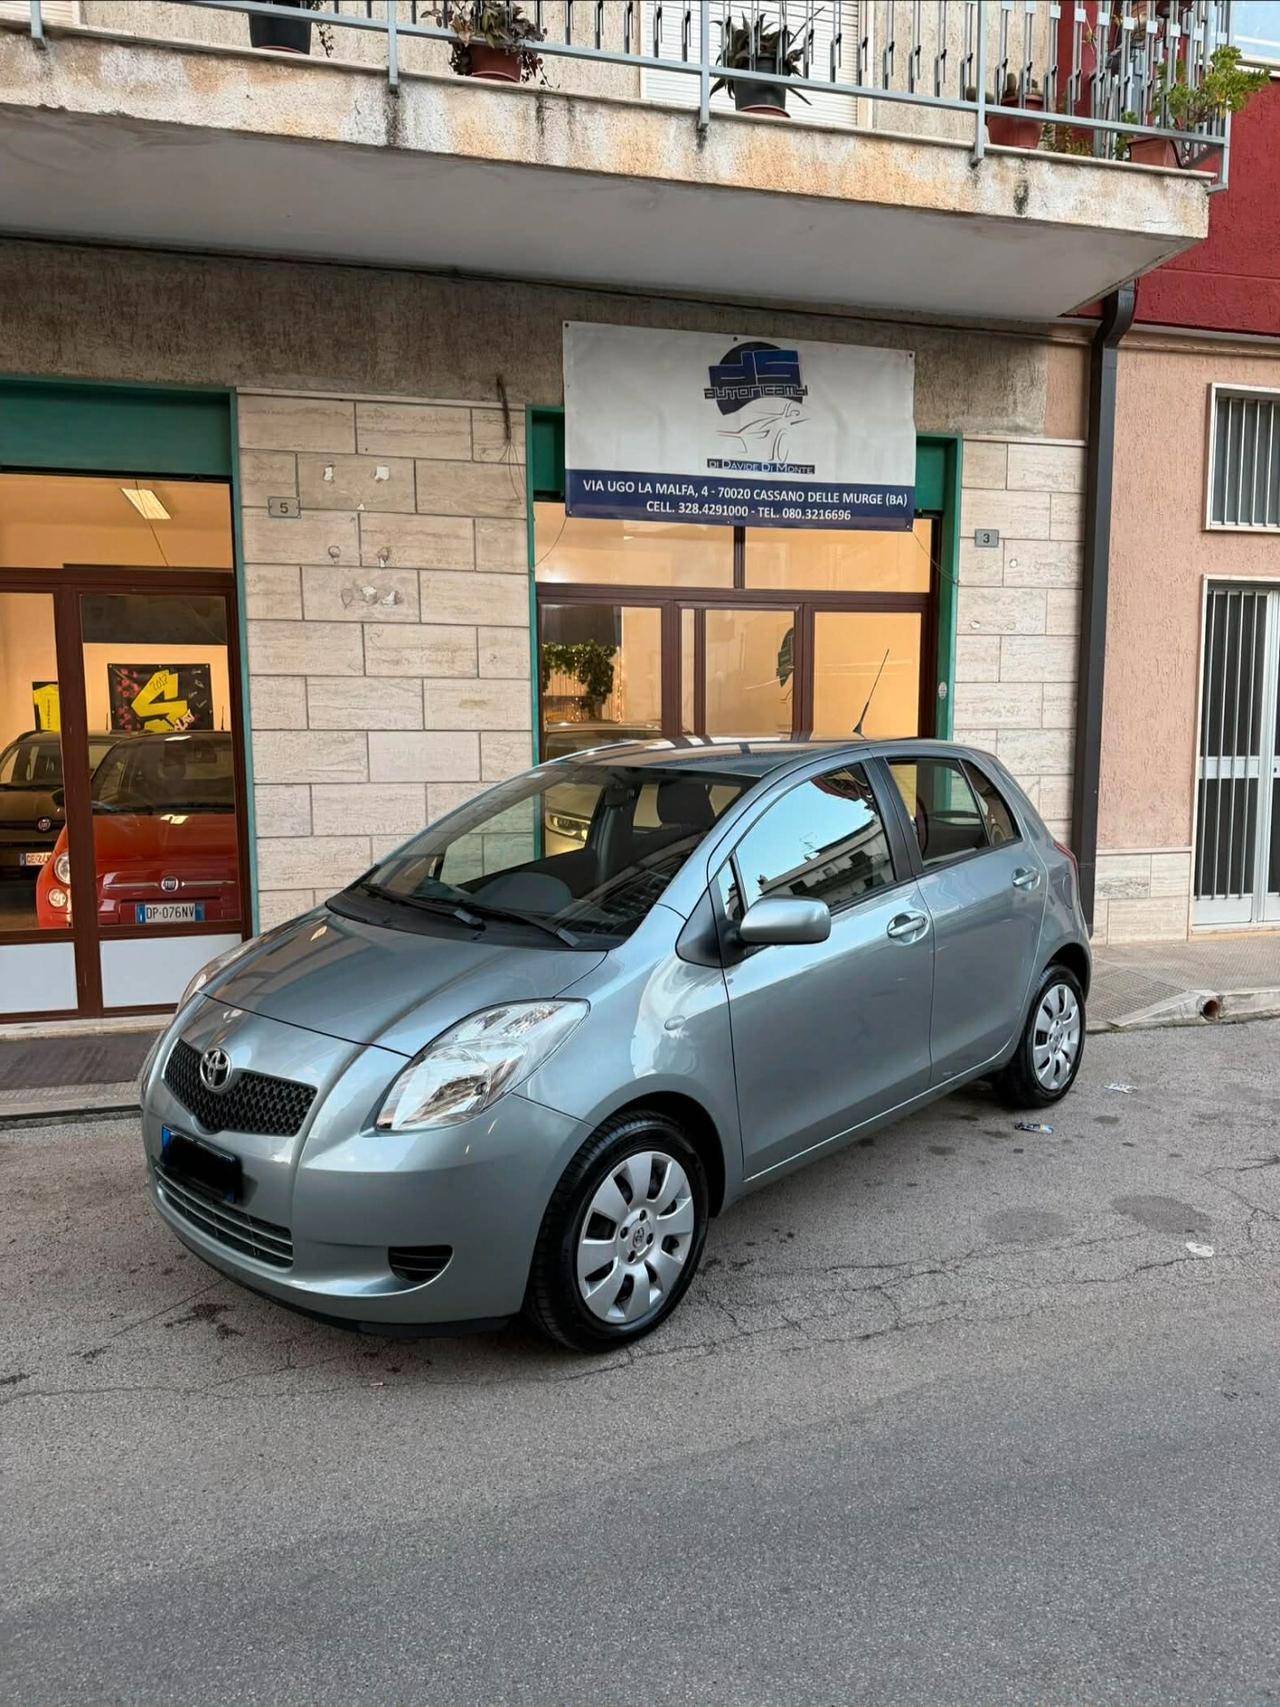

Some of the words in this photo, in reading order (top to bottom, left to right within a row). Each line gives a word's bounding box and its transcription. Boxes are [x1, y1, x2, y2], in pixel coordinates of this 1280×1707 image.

[776, 463, 814, 474] MONTE
[583, 479, 604, 492] VIA
[607, 481, 635, 493] UGO
[638, 482, 652, 494] LA
[655, 483, 699, 498] MALFA,
[701, 486, 708, 497] 4
[718, 487, 751, 500] 70020
[753, 489, 805, 502] CASSANO
[807, 491, 840, 503] DELLE
[842, 493, 883, 505] MURGE
[885, 493, 908, 507] (BA)
[280, 502, 288, 513] 5
[646, 501, 675, 513] CELL.
[678, 502, 749, 517] 328.4291000
[757, 507, 779, 518] TEL.
[782, 508, 851, 520] 080.3216696
[983, 533, 990, 544] 3
